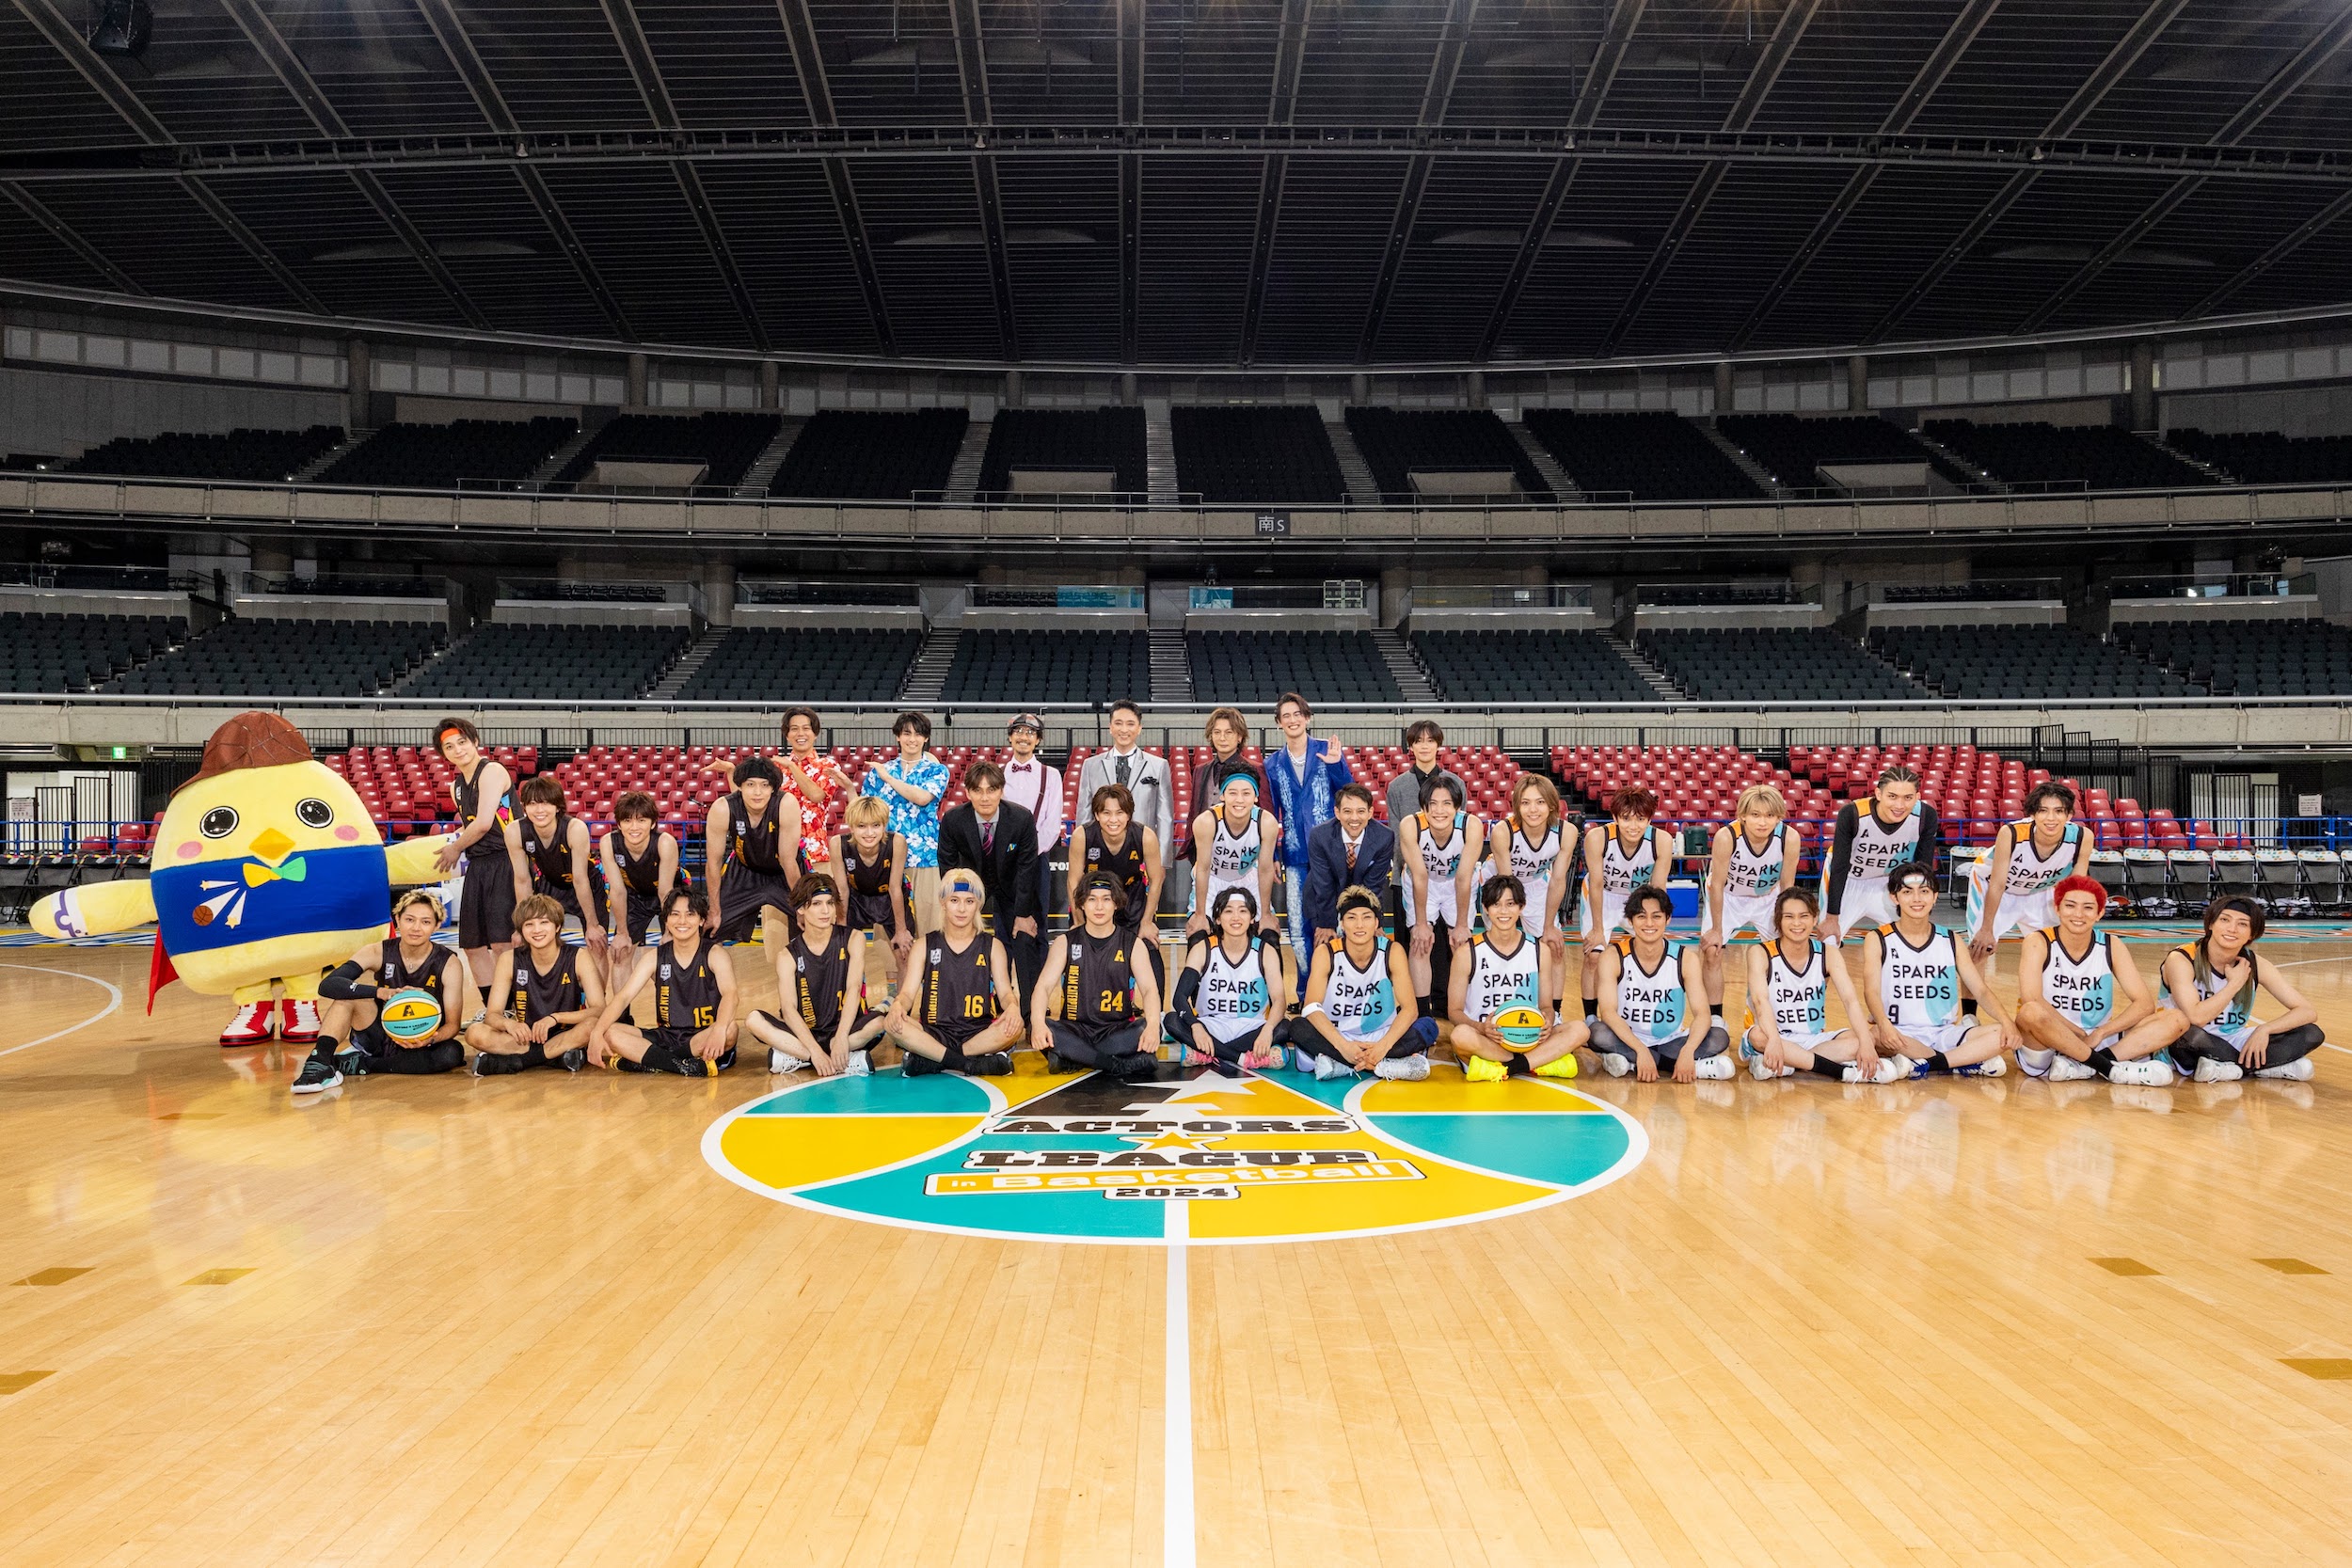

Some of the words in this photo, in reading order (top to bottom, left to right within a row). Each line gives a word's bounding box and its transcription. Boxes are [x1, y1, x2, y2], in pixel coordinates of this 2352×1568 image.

[1258, 515, 1274, 531] 南
[1277, 519, 1285, 532] S
[1215, 846, 1257, 859] SPARK
[1857, 842, 1910, 855] SPARK
[1603, 864, 1650, 879] SPARK
[1730, 861, 1780, 876] SPARK
[2009, 865, 2064, 879] SPARK
[1727, 872, 1777, 888] SEEDS
[1893, 965, 1948, 979] SPARK
[1208, 978, 1259, 994] SPARK
[1335, 980, 1381, 998] SPARK
[2053, 974, 2103, 990] SPARK
[1625, 988, 1674, 1003] SPARK
[1776, 986, 1823, 1003] SPARK
[1893, 985, 1950, 1000] SEEDS
[928, 990, 938, 1023] CATERPILLA
[964, 994, 984, 1018] 16
[1100, 990, 1124, 1012] 24
[1207, 998, 1260, 1013] SEEDS
[1331, 1001, 1382, 1017] SEEDS
[2051, 994, 2104, 1011] SEEDS
[693, 1006, 714, 1028] 15
[1621, 1006, 1676, 1023] SEEDS
[1888, 1004, 1899, 1024] 9
[2207, 1011, 2247, 1025] EDS
[993, 1120, 1350, 1132] ACTORS
[974, 1151, 1370, 1166] LEAGUE
[951, 1180, 977, 1188] in
[992, 1164, 1393, 1189] Basketball
[1116, 1187, 1229, 1197] 2024
